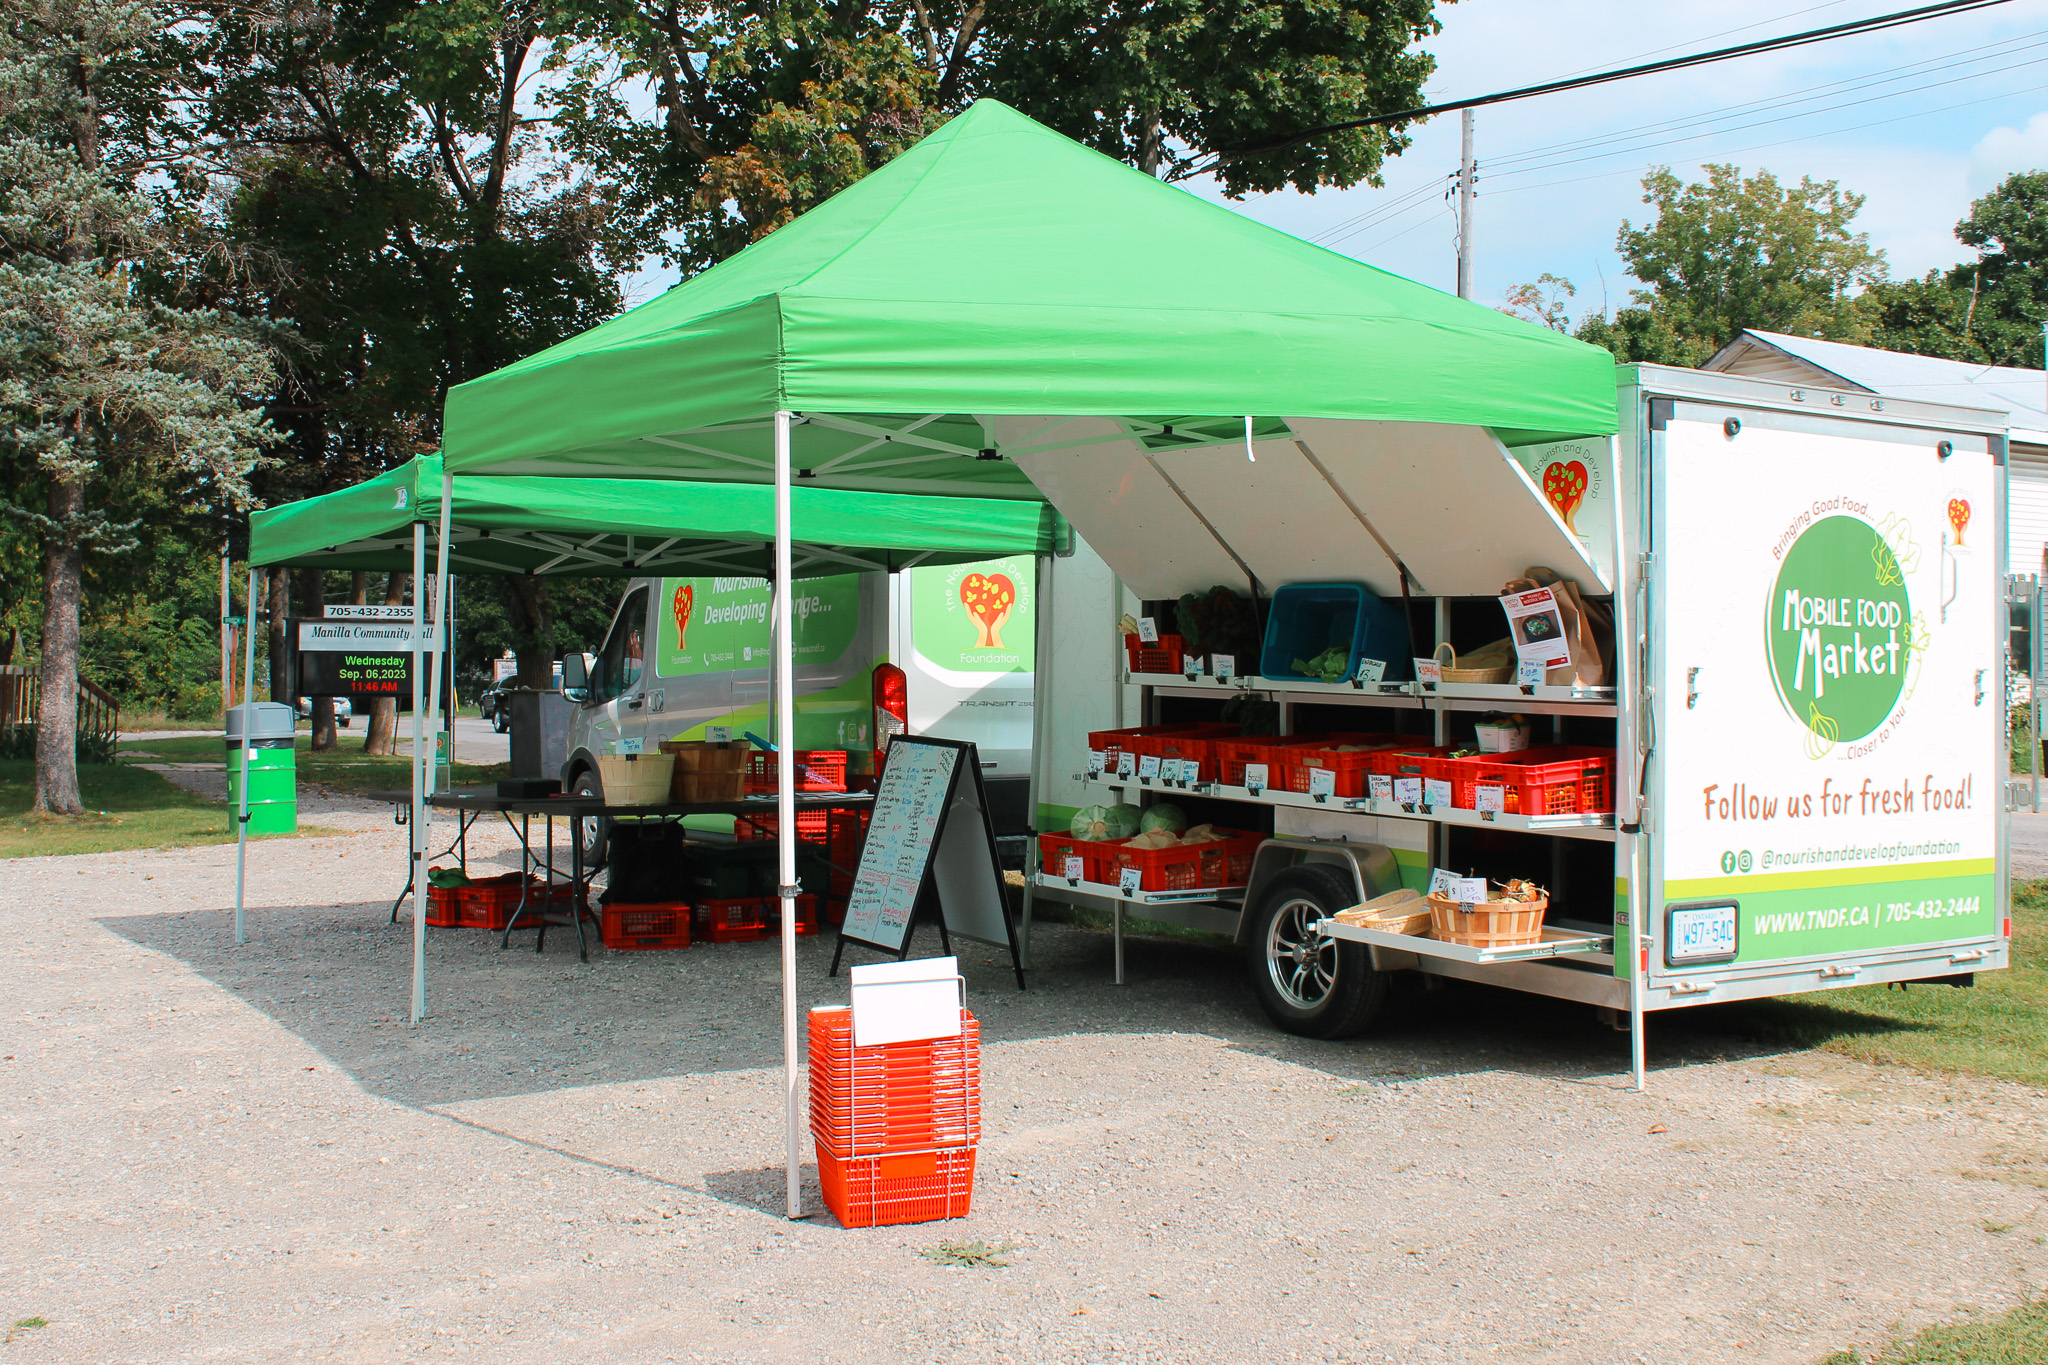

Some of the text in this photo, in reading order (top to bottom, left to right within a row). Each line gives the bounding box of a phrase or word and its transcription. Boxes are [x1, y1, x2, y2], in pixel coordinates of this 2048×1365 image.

[1532, 444, 1602, 499] Nourish and Develop
[1772, 510, 1811, 560] Bringing
[1812, 495, 1840, 516] Good
[946, 589, 957, 612] The
[1007, 563, 1031, 614] Develop
[329, 607, 414, 617] 705-432-2355
[704, 596, 832, 625] Developing nge...
[1782, 589, 1903, 631] MOBILE FOOD
[311, 626, 351, 638] Manilla
[353, 627, 410, 641] Community
[345, 656, 405, 668] Wednesday
[671, 655, 692, 664] Foundation
[960, 652, 1020, 663] Foundation
[1793, 628, 1901, 699] Market
[339, 669, 406, 681] Sep. 06,2023
[351, 682, 398, 691] 11:46 AM
[1879, 729, 1889, 743] to
[1889, 705, 1906, 730] You
[1703, 772, 1972, 822] Follow us for fresh food!
[1761, 839, 1961, 869] @nourishanddevelopfoundation
[1754, 905, 1869, 935] WWW.TNDF.CA
[1886, 896, 1981, 923] 705-432-2444
